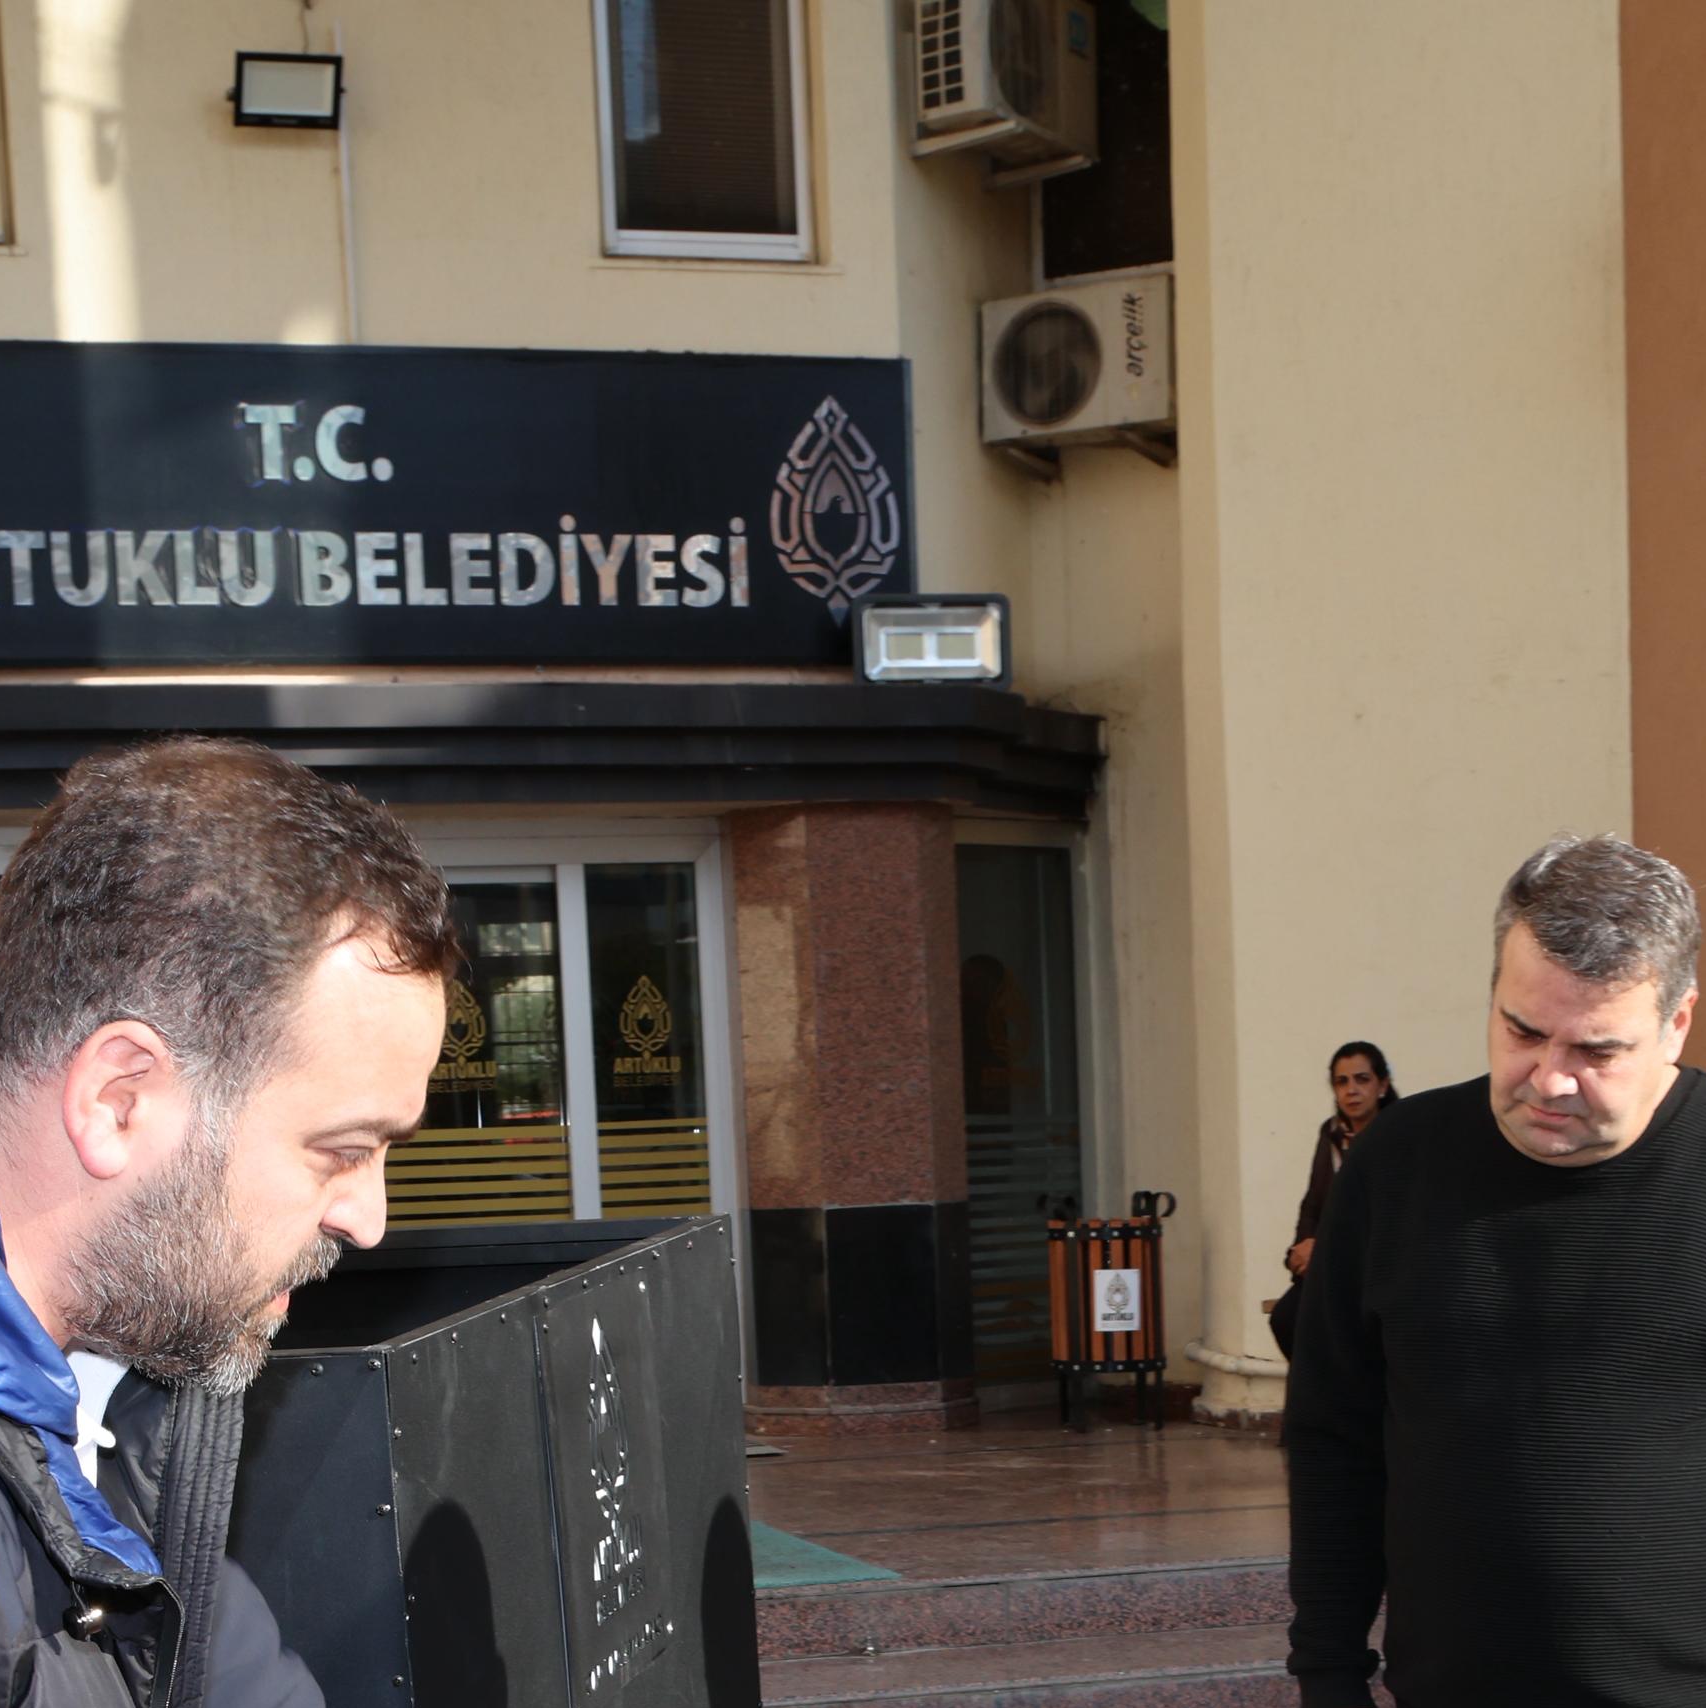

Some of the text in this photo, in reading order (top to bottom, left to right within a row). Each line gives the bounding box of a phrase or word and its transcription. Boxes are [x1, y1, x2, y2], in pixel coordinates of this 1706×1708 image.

[1121, 292, 1148, 377] arçelik
[244, 404, 394, 482] T.C.
[296, 514, 750, 607] BELEDİYESİ
[613, 1056, 681, 1073] ARTUKLU
